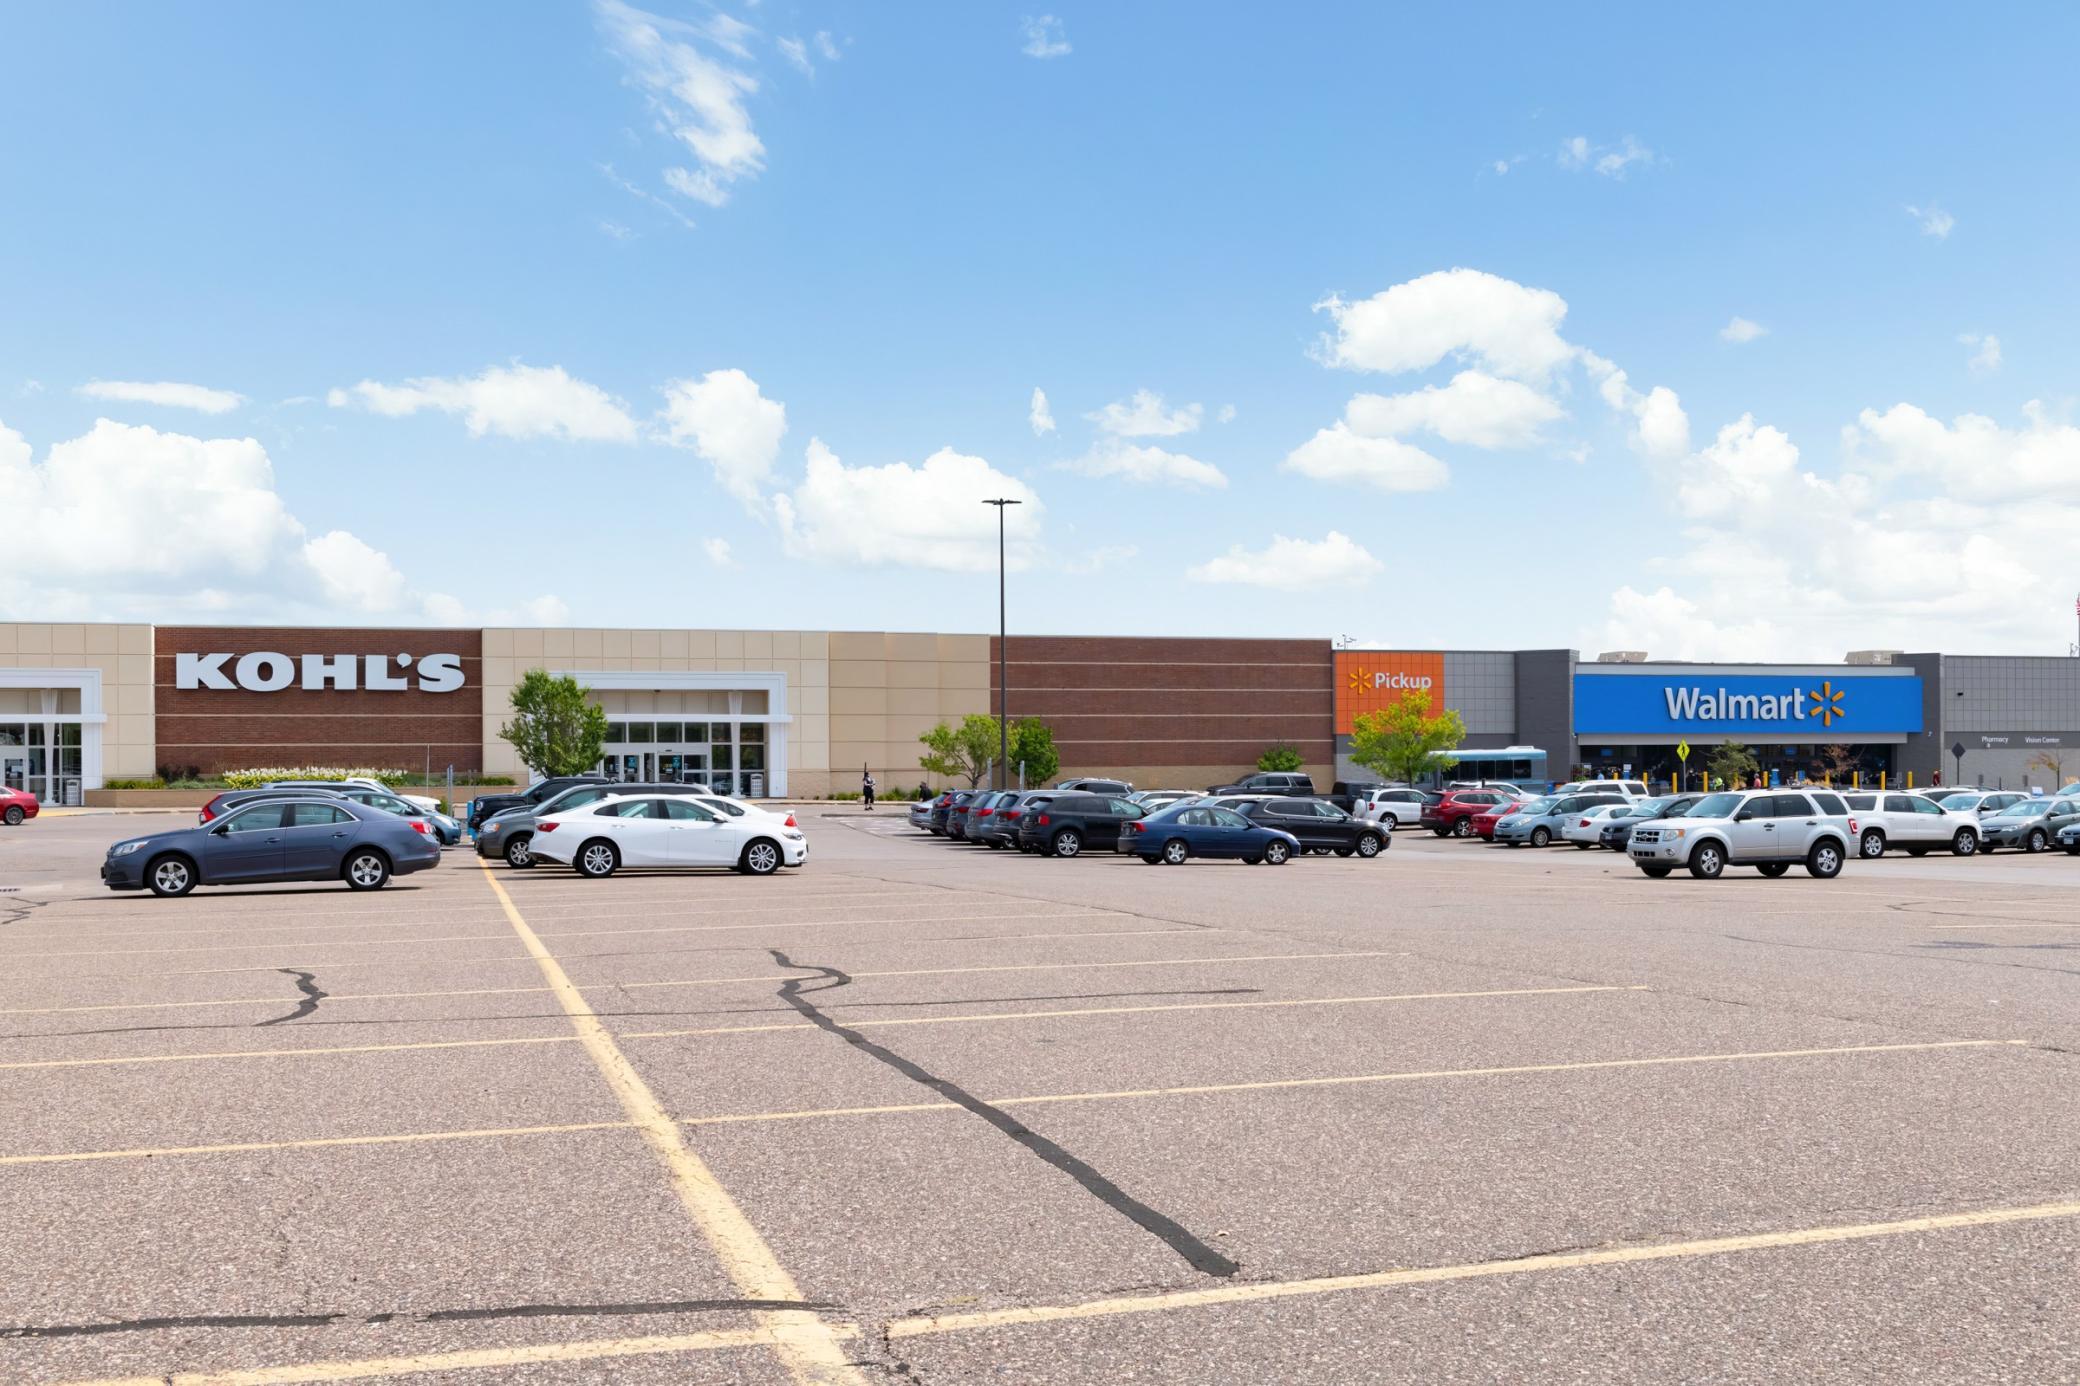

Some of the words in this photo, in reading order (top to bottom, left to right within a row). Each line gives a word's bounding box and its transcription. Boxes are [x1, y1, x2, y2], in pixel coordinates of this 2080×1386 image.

[175, 651, 466, 693] KOHL'S
[1375, 671, 1432, 691] Pickup
[1665, 687, 1805, 720] Walmart
[1981, 736, 2009, 744] Pharmacy
